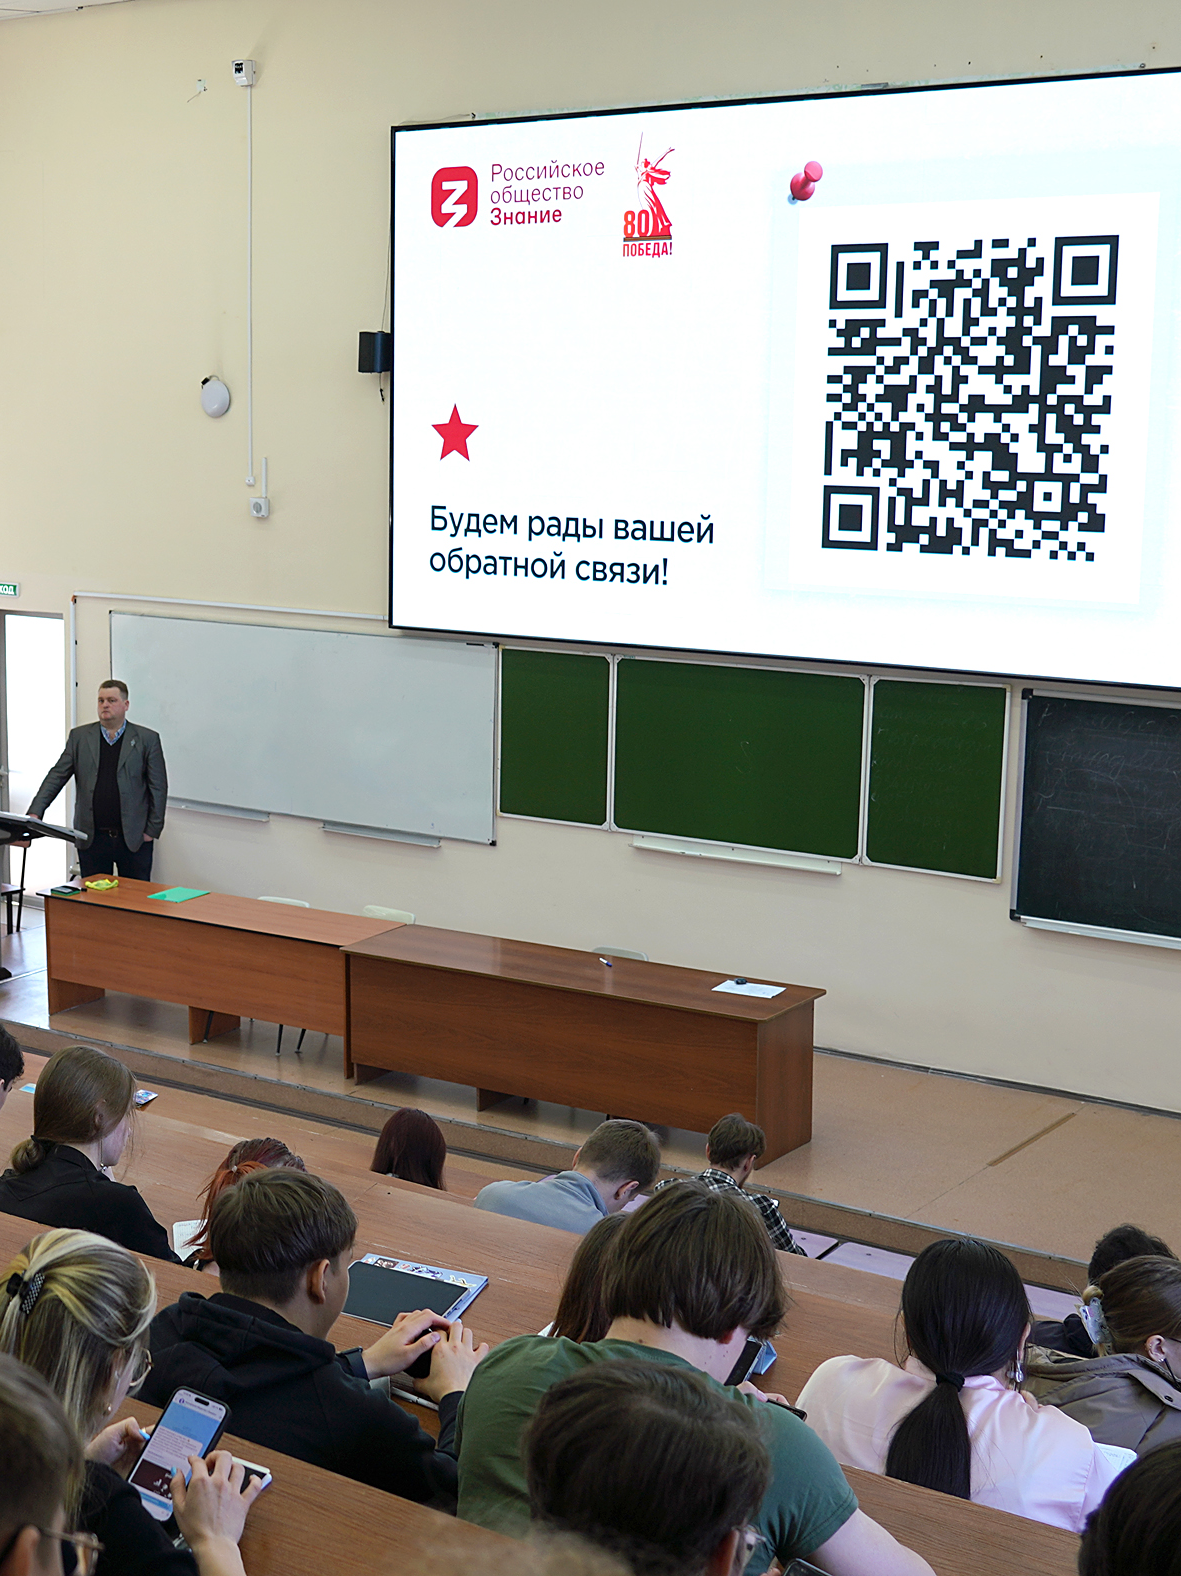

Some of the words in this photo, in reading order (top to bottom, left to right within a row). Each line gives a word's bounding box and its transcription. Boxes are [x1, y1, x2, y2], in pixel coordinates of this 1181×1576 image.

[490, 159, 605, 183] Российское
[490, 184, 584, 205] общество
[490, 208, 562, 226] Знание
[623, 210, 650, 237] 80
[622, 242, 673, 258] ПОБЕДА!
[430, 505, 518, 538] Будем
[527, 514, 604, 543] рады
[613, 514, 714, 544] вашей
[429, 547, 566, 579] обратной
[575, 557, 668, 586] связи!
